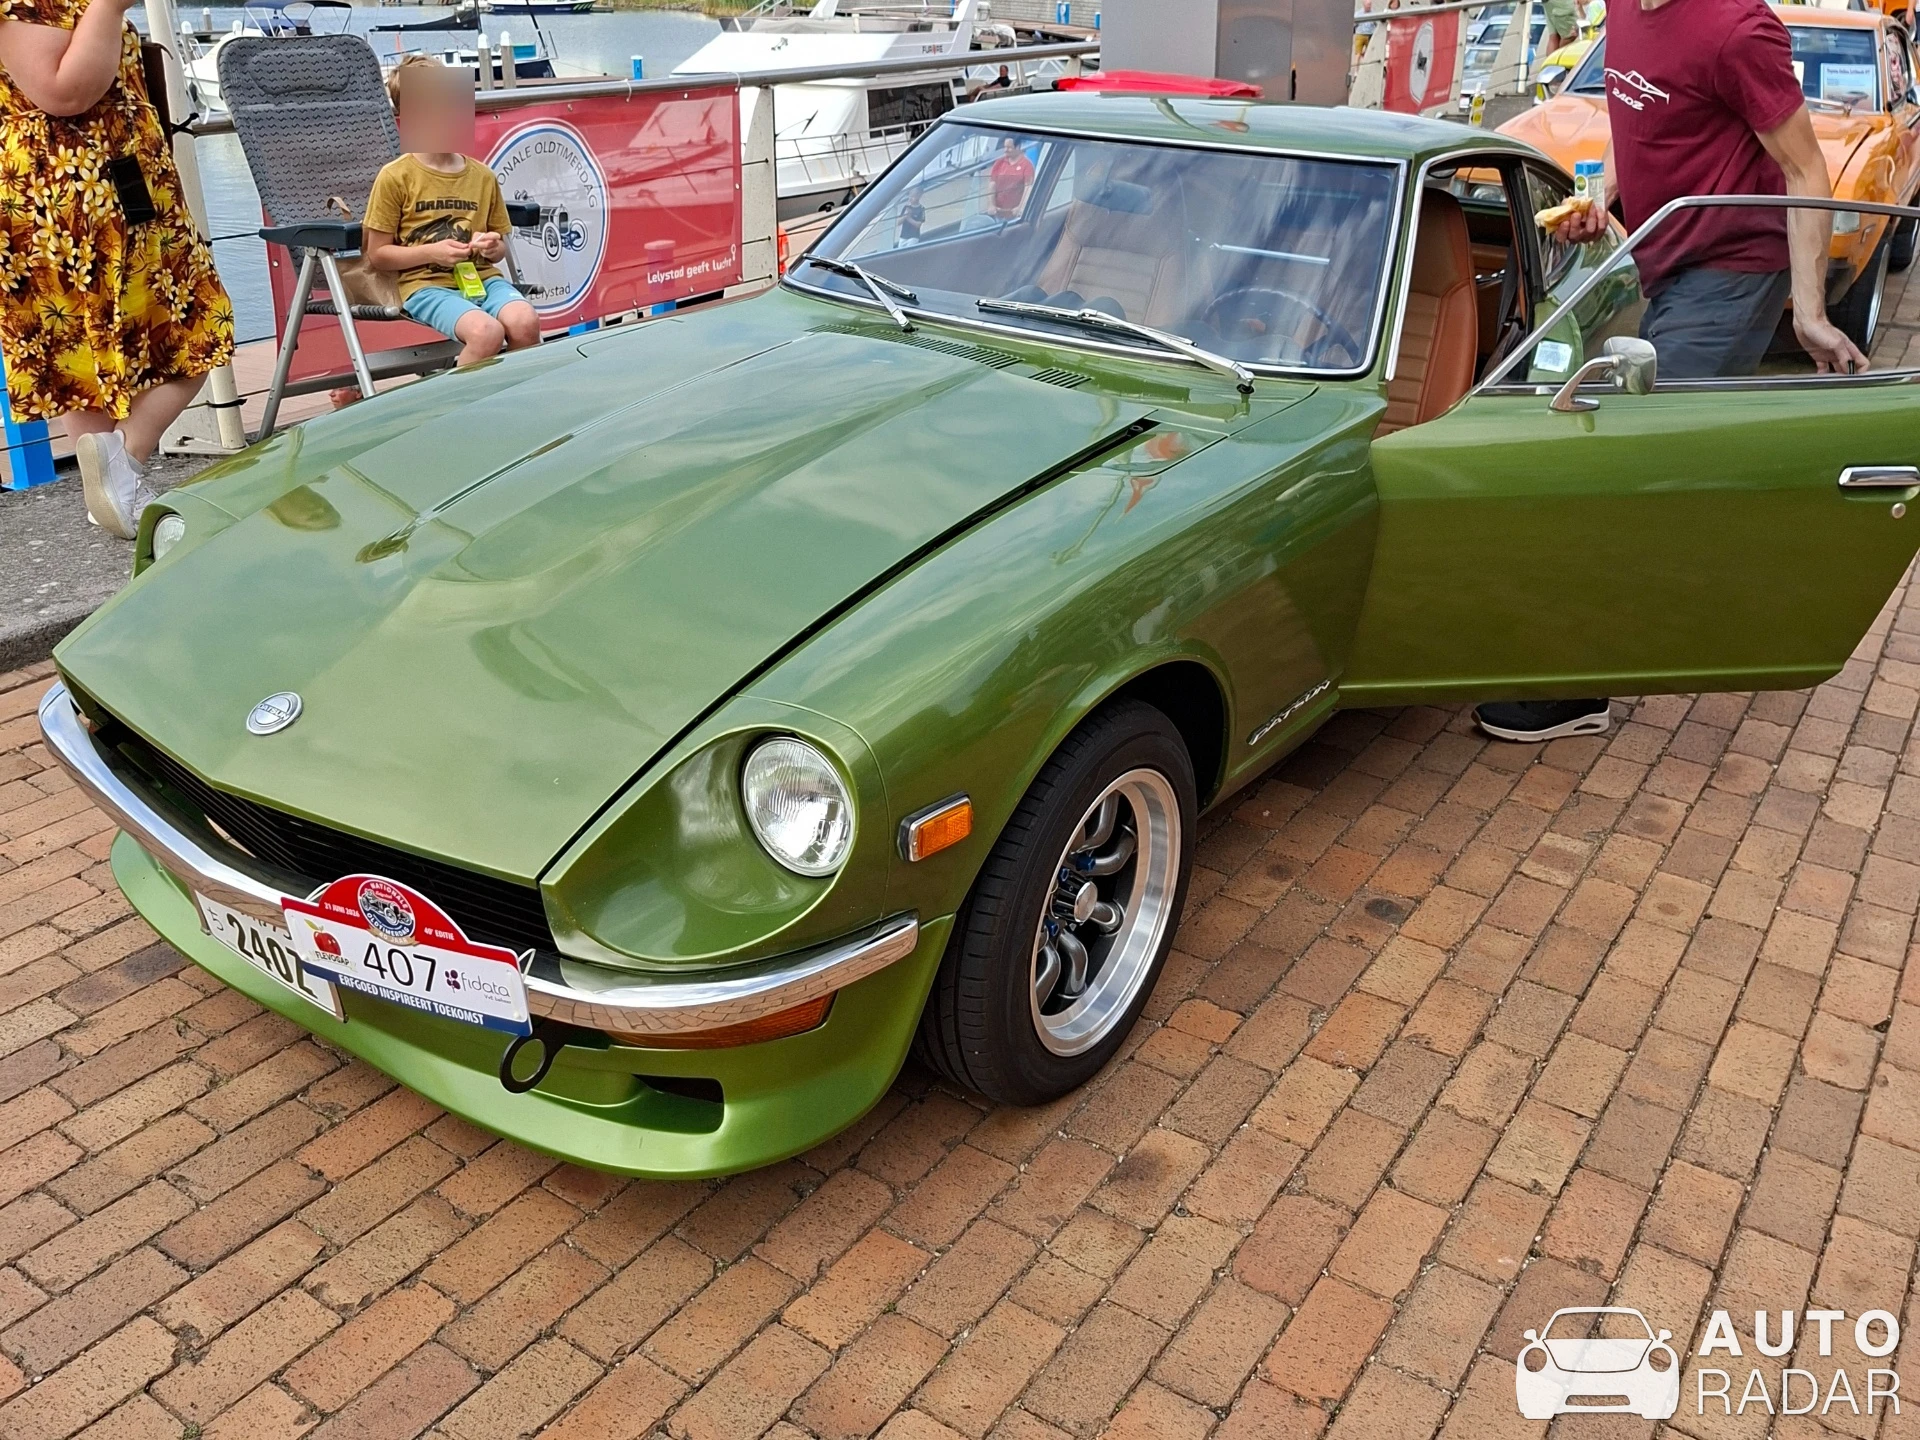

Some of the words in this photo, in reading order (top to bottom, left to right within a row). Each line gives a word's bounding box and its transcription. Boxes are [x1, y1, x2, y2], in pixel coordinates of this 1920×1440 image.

[1612, 87, 1645, 111] 240Z
[496, 145, 532, 186] ONALE
[534, 141, 598, 208] OLDTIMERDAG
[415, 199, 478, 213] DRAGONS
[647, 264, 684, 284] Lelystad
[686, 261, 710, 279] geeft
[712, 257, 732, 272] lucht
[370, 882, 409, 910] NATIONALE
[363, 942, 437, 993] 407
[461, 972, 511, 998] fidata
[339, 974, 379, 997] ERFGOED
[379, 987, 433, 1013] INSPIREERT
[433, 1001, 484, 1026] TOEKOMST
